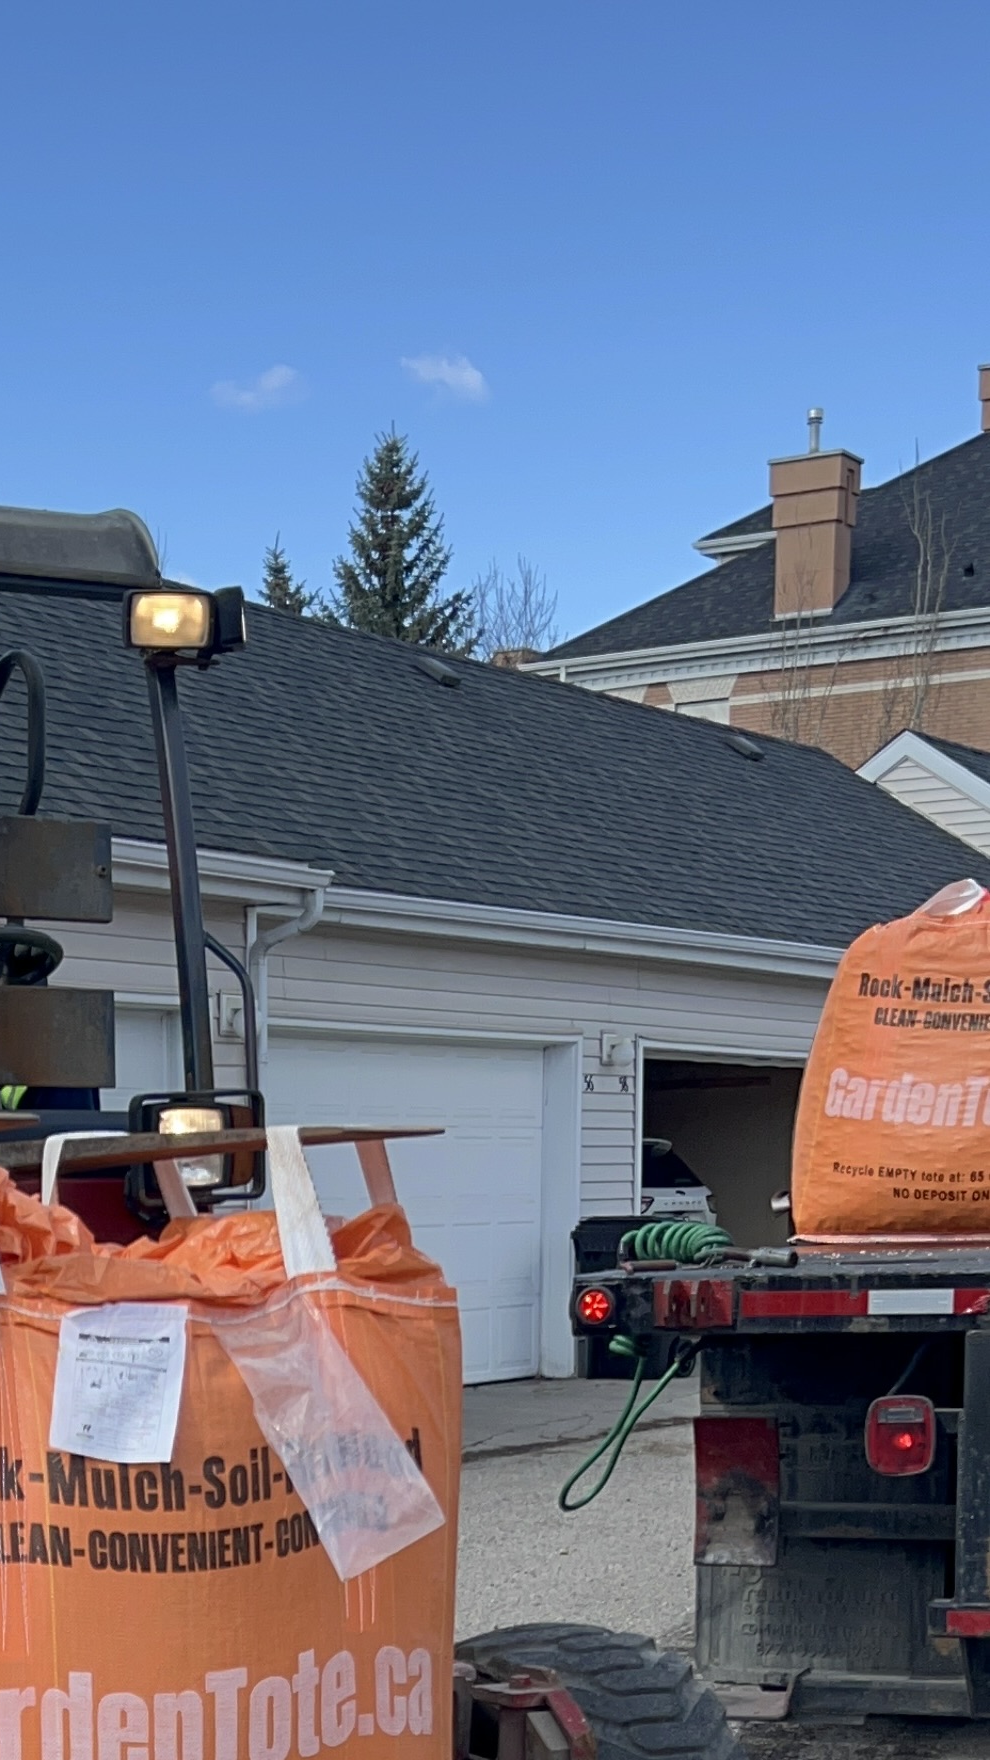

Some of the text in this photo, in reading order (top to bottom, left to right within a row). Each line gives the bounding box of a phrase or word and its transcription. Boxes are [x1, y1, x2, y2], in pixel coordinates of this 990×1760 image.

[832, 1161, 985, 1183] Recycle EMPTY tote at: 65
[893, 1187, 990, 1202] NO DEPOSIT ON
